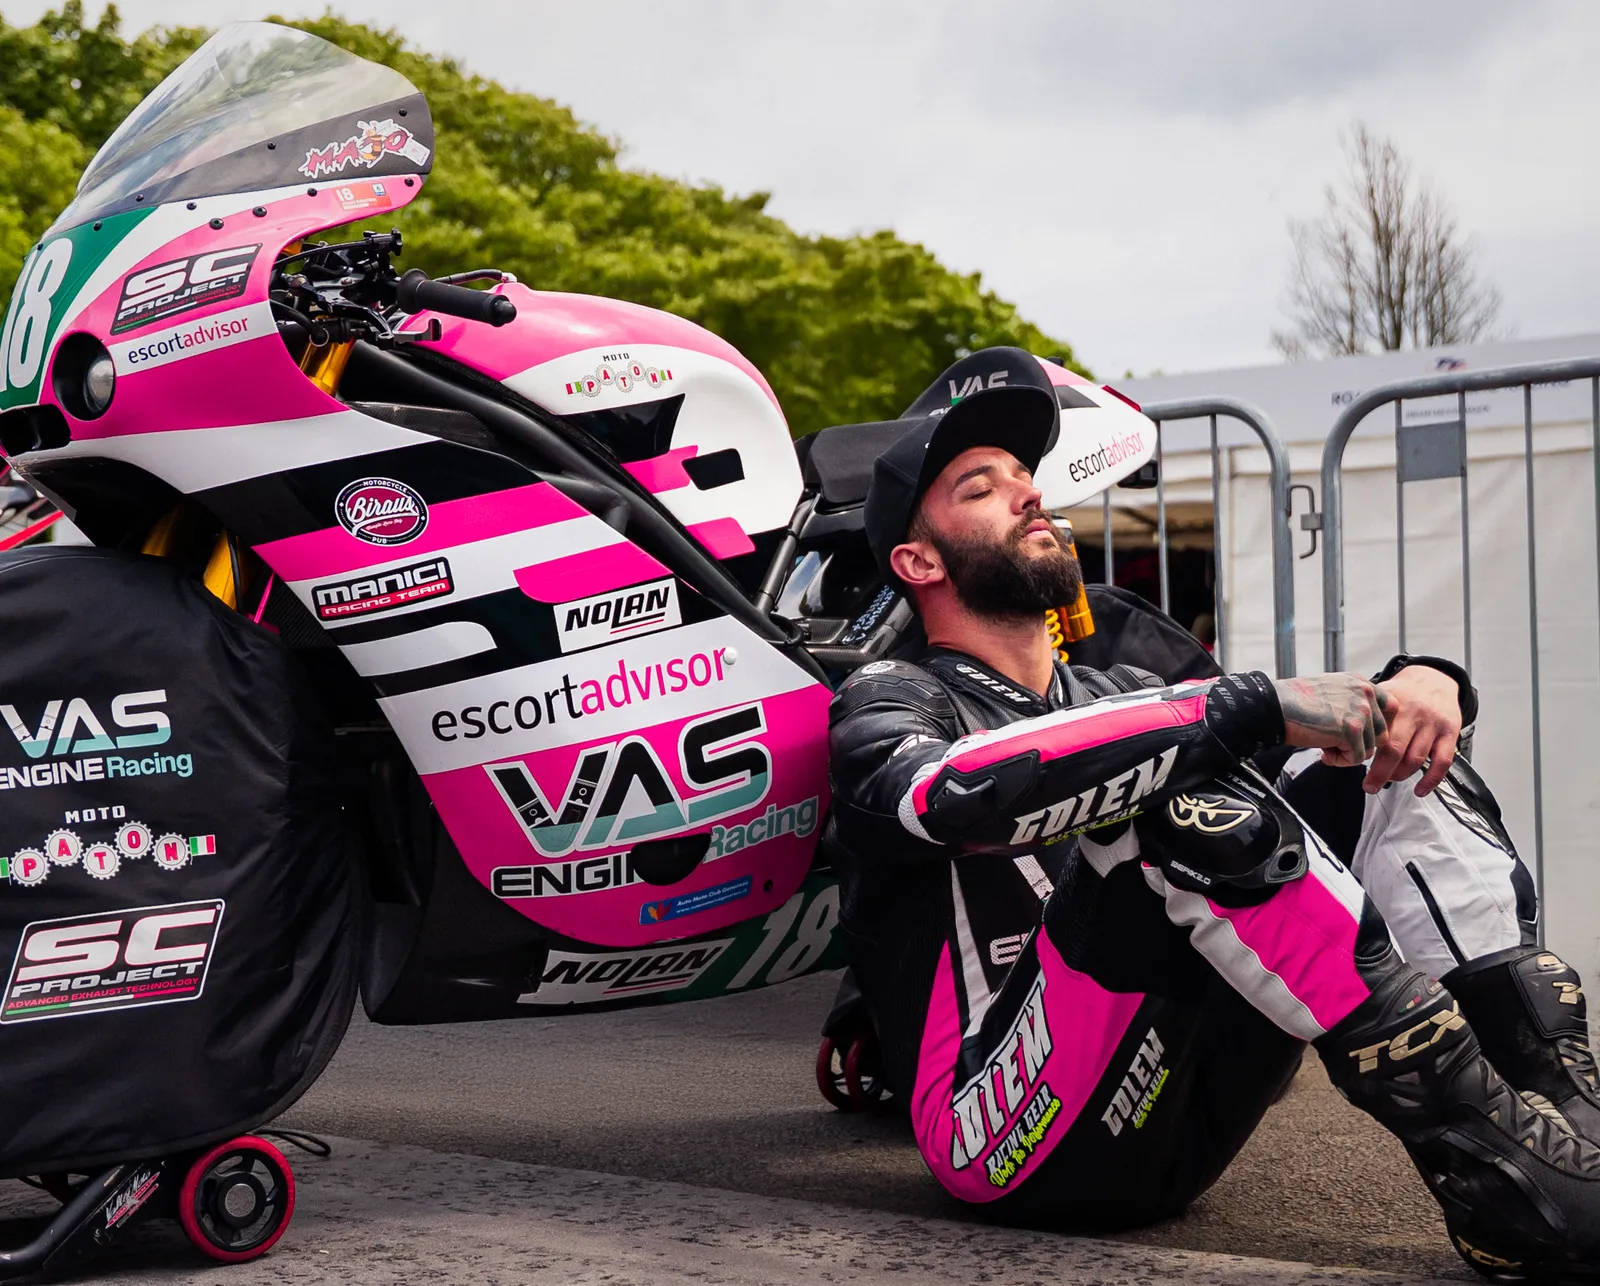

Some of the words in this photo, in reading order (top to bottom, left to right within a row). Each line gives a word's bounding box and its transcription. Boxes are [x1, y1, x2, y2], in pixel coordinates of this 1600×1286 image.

[336, 187, 354, 202] 18
[117, 273, 245, 320] PROJECT
[121, 245, 258, 310] SC
[0, 238, 73, 391] 18
[128, 317, 249, 364] escortadvisor
[603, 352, 630, 362] MOTO
[585, 364, 660, 393] PATON
[1069, 431, 1144, 482] escortadvisor
[362, 479, 408, 494] MOTORCYCLE
[371, 536, 388, 544] PUB
[317, 561, 447, 605] MANICI
[325, 596, 391, 615] RACING
[397, 582, 446, 600] TEAM
[565, 586, 670, 629] NOLAN
[431, 647, 726, 742] escortadvisor
[0, 689, 172, 758] VAS
[106, 751, 193, 778] Racing
[486, 702, 770, 856] VAS
[65, 805, 126, 824] MOTO
[1009, 744, 1179, 845] GOLEM
[19, 828, 183, 880] PATON
[493, 853, 643, 897] ENGI
[702, 798, 818, 862] Racing
[16, 908, 216, 982] SC
[725, 884, 842, 990] 18
[11, 961, 203, 998] PROJECT
[541, 946, 718, 990] NOLAN
[7, 994, 68, 1010] ADVANCED
[71, 987, 122, 1001] EXHAUST
[125, 977, 199, 994] TECHNOLOGY
[1348, 999, 1466, 1073] TCX
[1101, 1027, 1164, 1137] GOLEM
[985, 1122, 1027, 1175] RACING
[1021, 1083, 1052, 1130] GEAR
